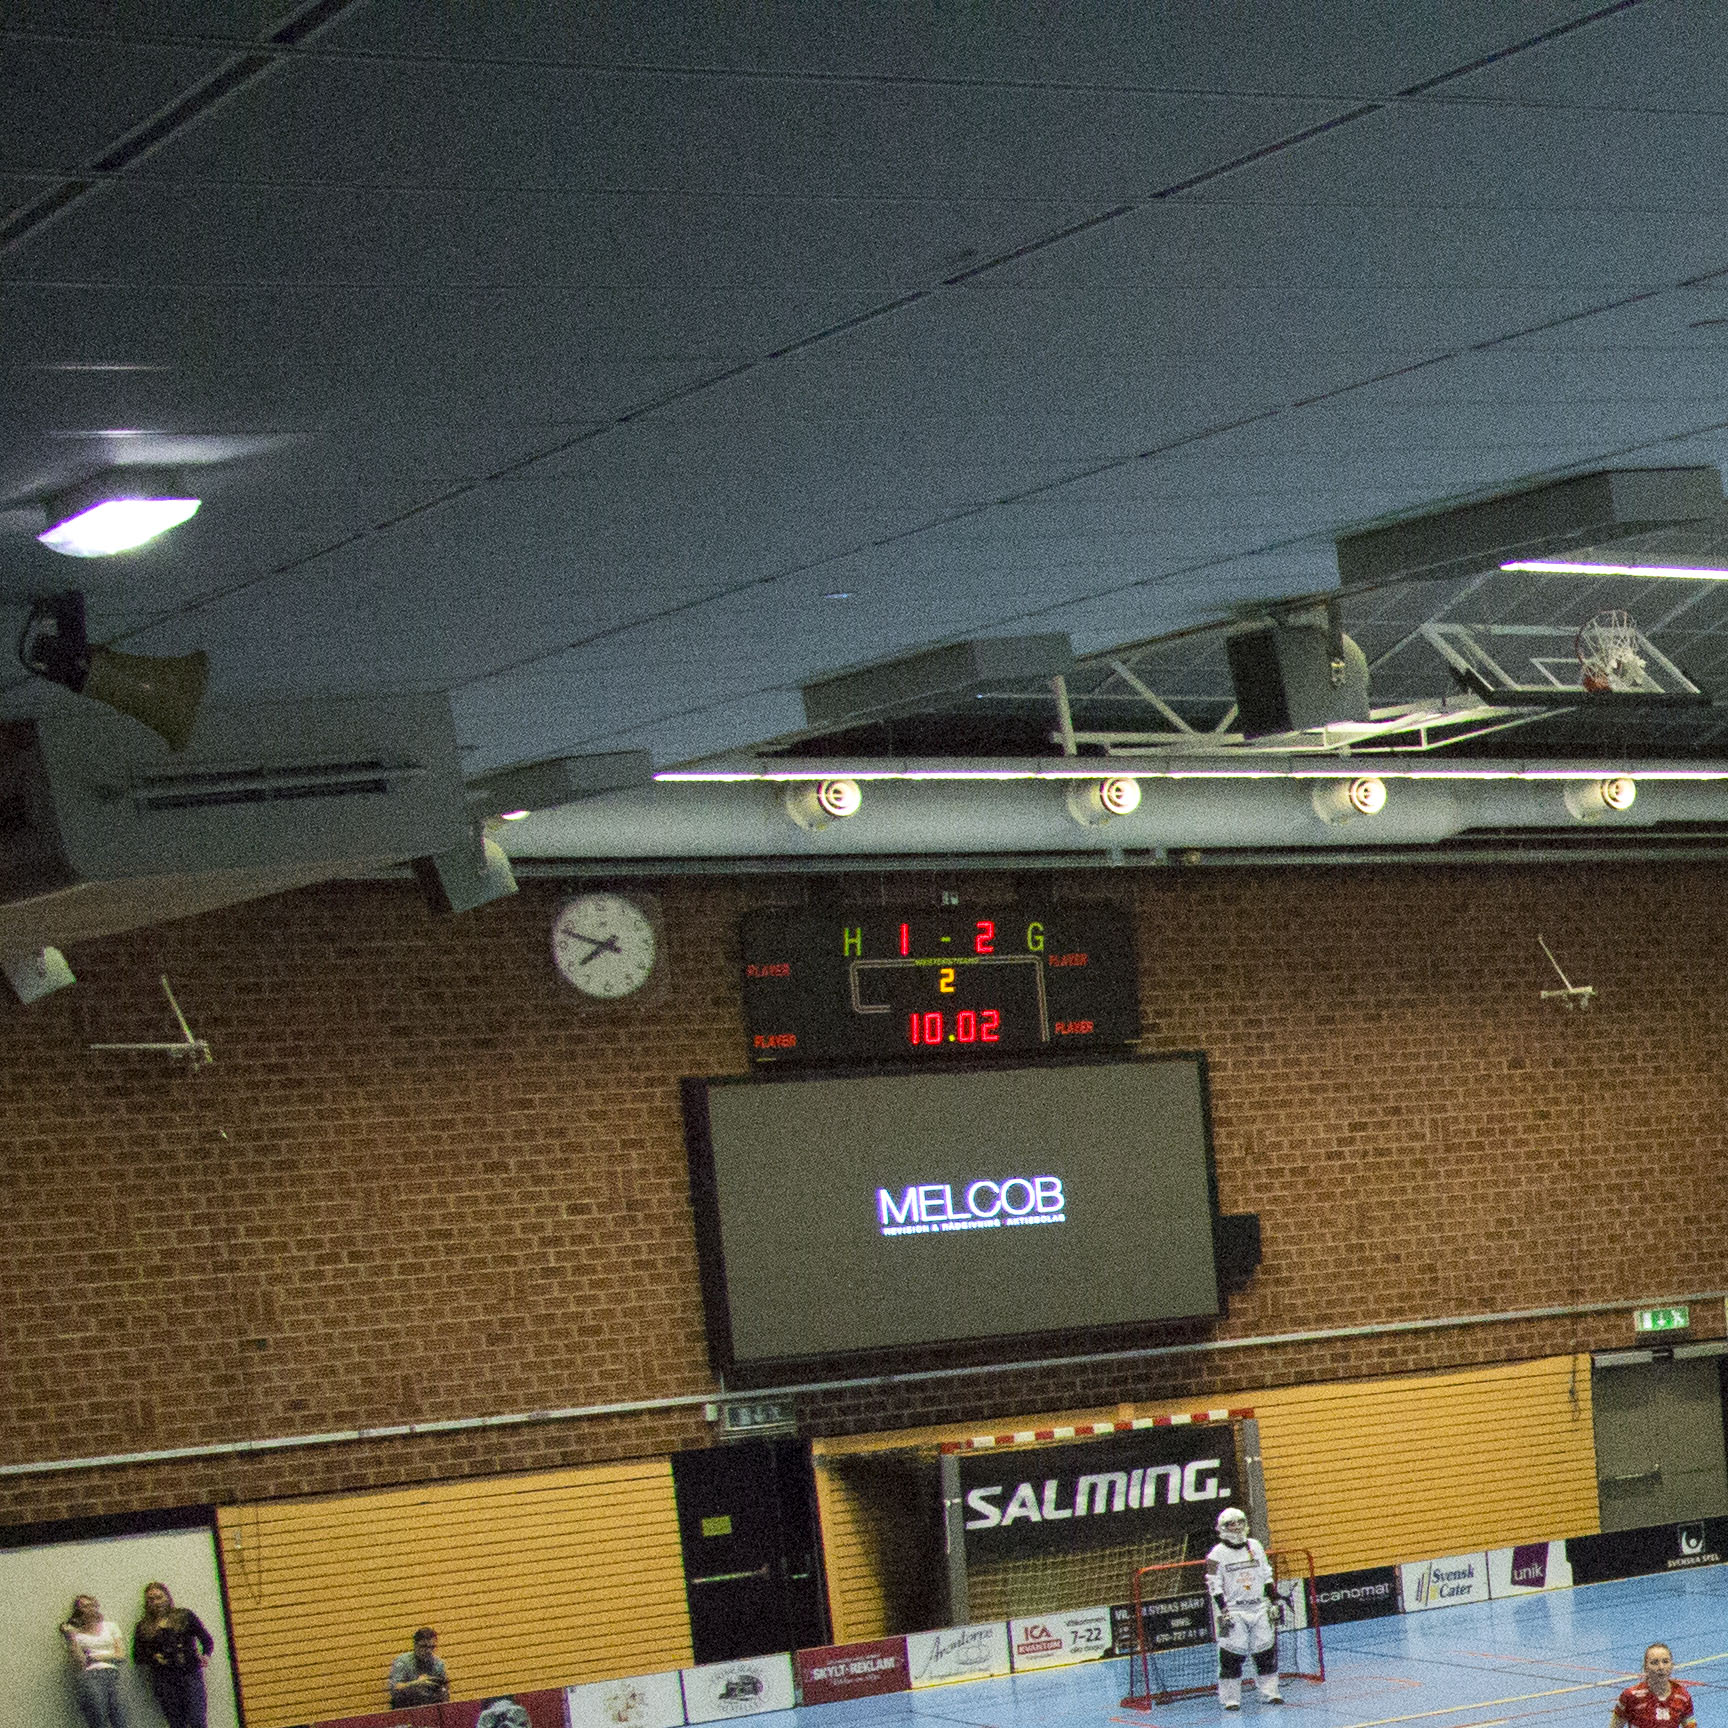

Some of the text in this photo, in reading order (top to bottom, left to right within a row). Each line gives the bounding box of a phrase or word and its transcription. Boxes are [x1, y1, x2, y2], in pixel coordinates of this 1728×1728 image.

[843, 927, 863, 957] H
[899, 922, 910, 956] 1
[974, 920, 996, 955] 2
[1026, 921, 1045, 952] G
[1049, 953, 1088, 967] PLAYER
[747, 963, 791, 978] PLAYER
[939, 968, 956, 994] 2
[909, 1008, 1001, 1046] 10.02
[1054, 1020, 1095, 1035] PLAYER
[754, 1033, 798, 1049] PLAYER
[877, 1175, 1066, 1226] MELCOB
[1432, 1563, 1475, 1583] Svensk
[1513, 1562, 1544, 1582] unik
[1438, 1582, 1473, 1600] Cater
[1024, 1623, 1052, 1642] ICA
[1070, 1627, 1104, 1646] 7-22
